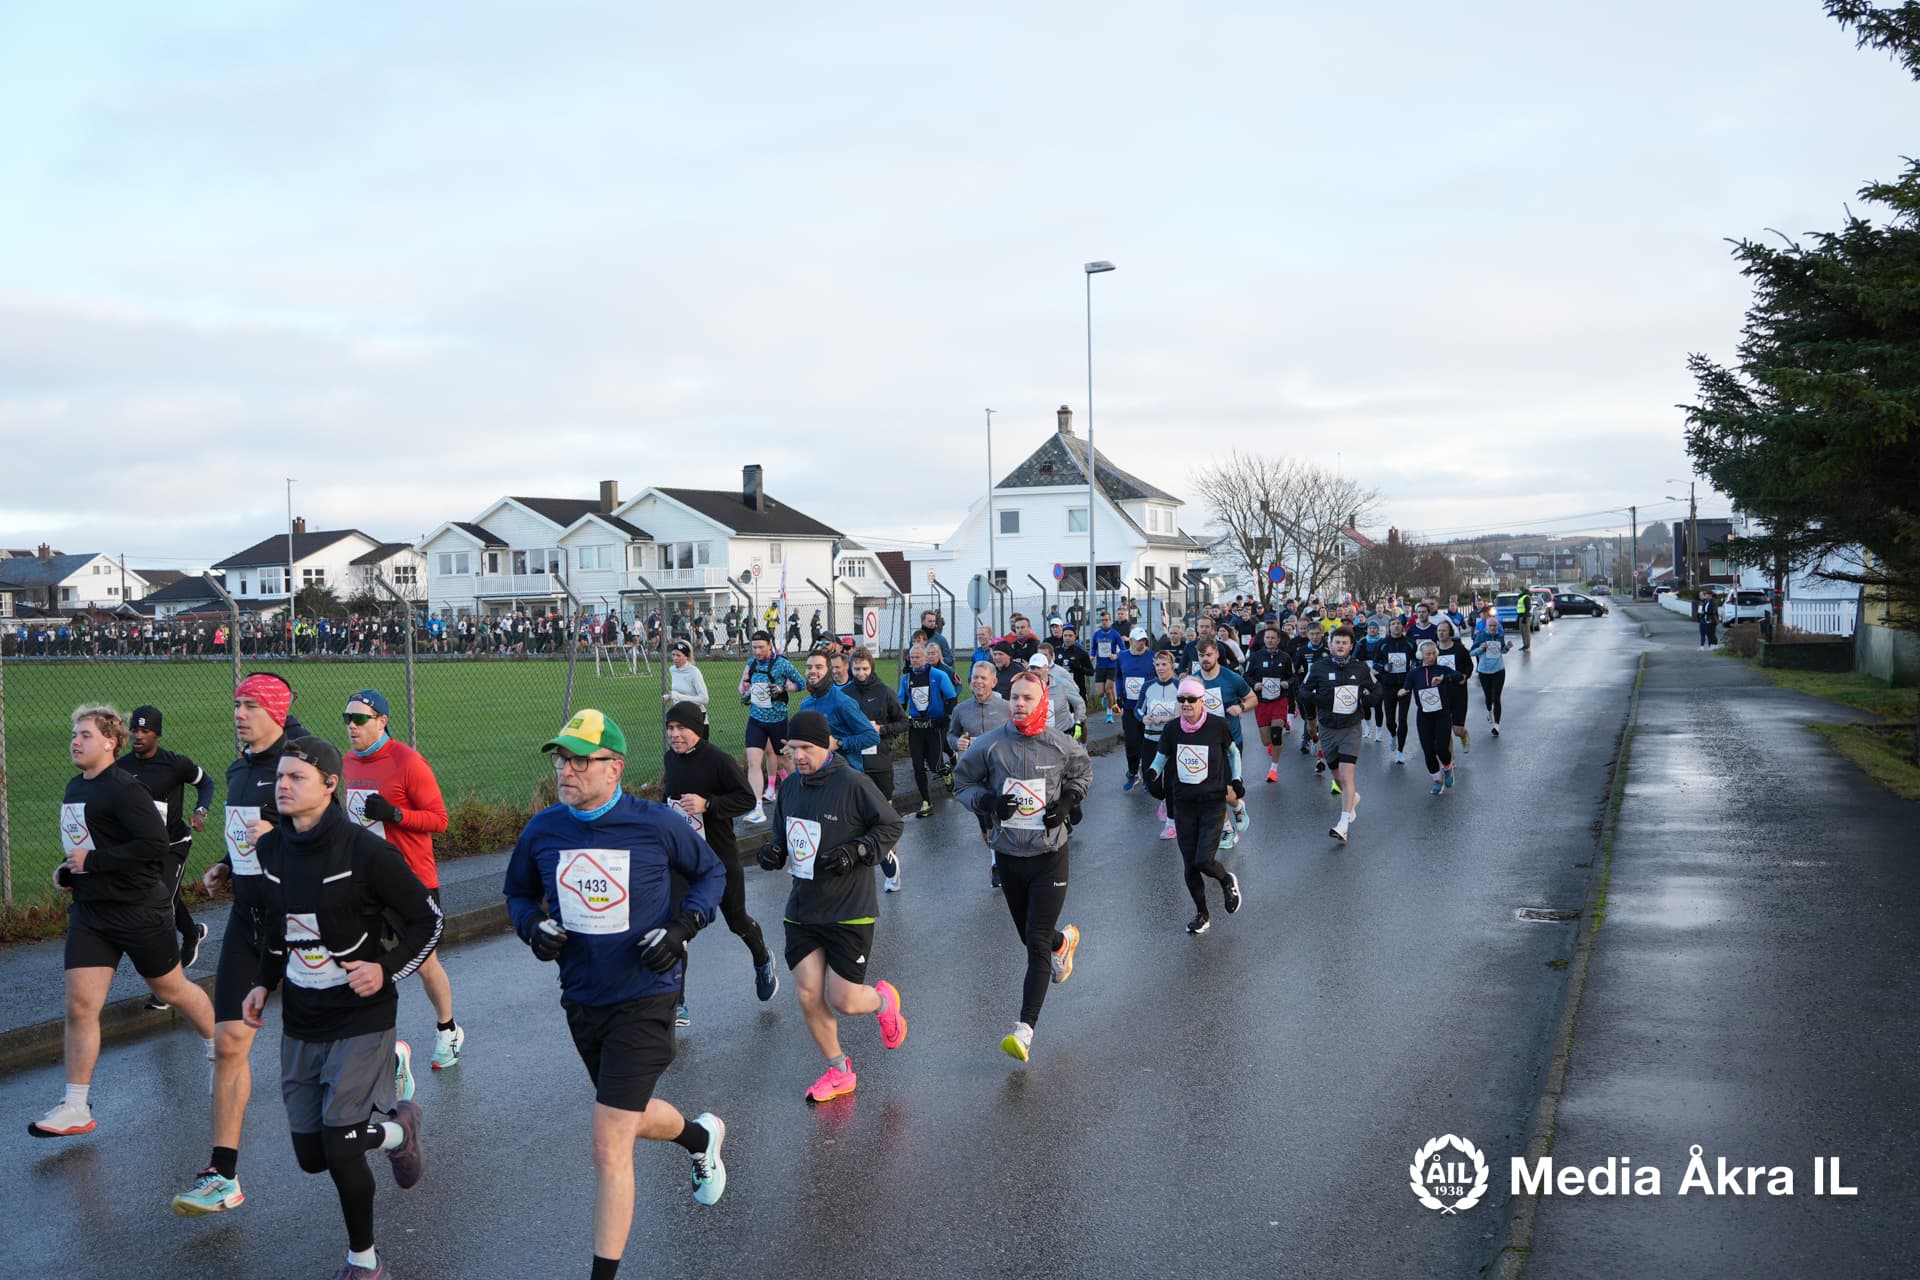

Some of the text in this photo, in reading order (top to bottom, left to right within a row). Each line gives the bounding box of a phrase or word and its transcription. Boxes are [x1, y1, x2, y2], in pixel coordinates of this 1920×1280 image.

[1015, 796, 1034, 806] 1216
[793, 838, 808, 849] 1181
[577, 880, 608, 893] 1433
